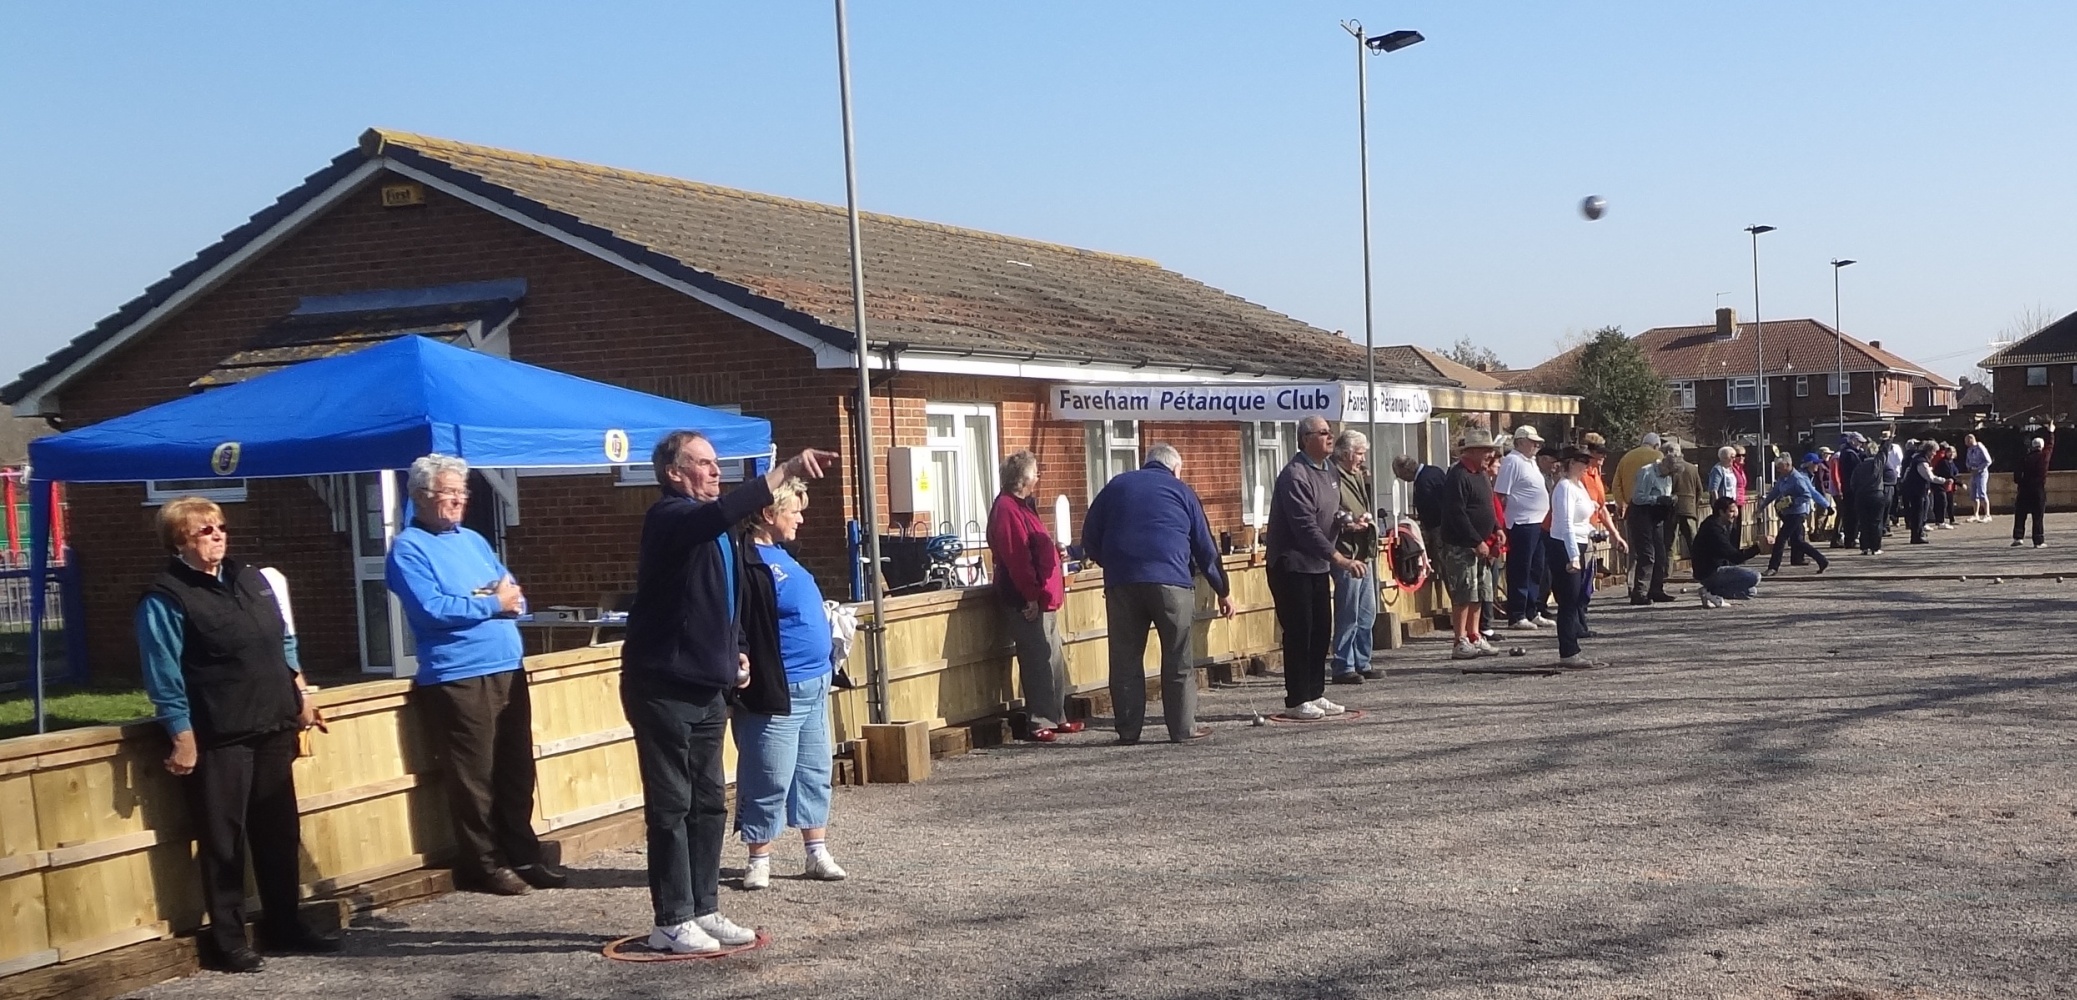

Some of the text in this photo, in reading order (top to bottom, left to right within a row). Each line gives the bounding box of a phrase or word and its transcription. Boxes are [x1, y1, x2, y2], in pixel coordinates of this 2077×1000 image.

[1060, 388, 1330, 415] Fareham Pétanque Club
[1413, 393, 1429, 412] Club
